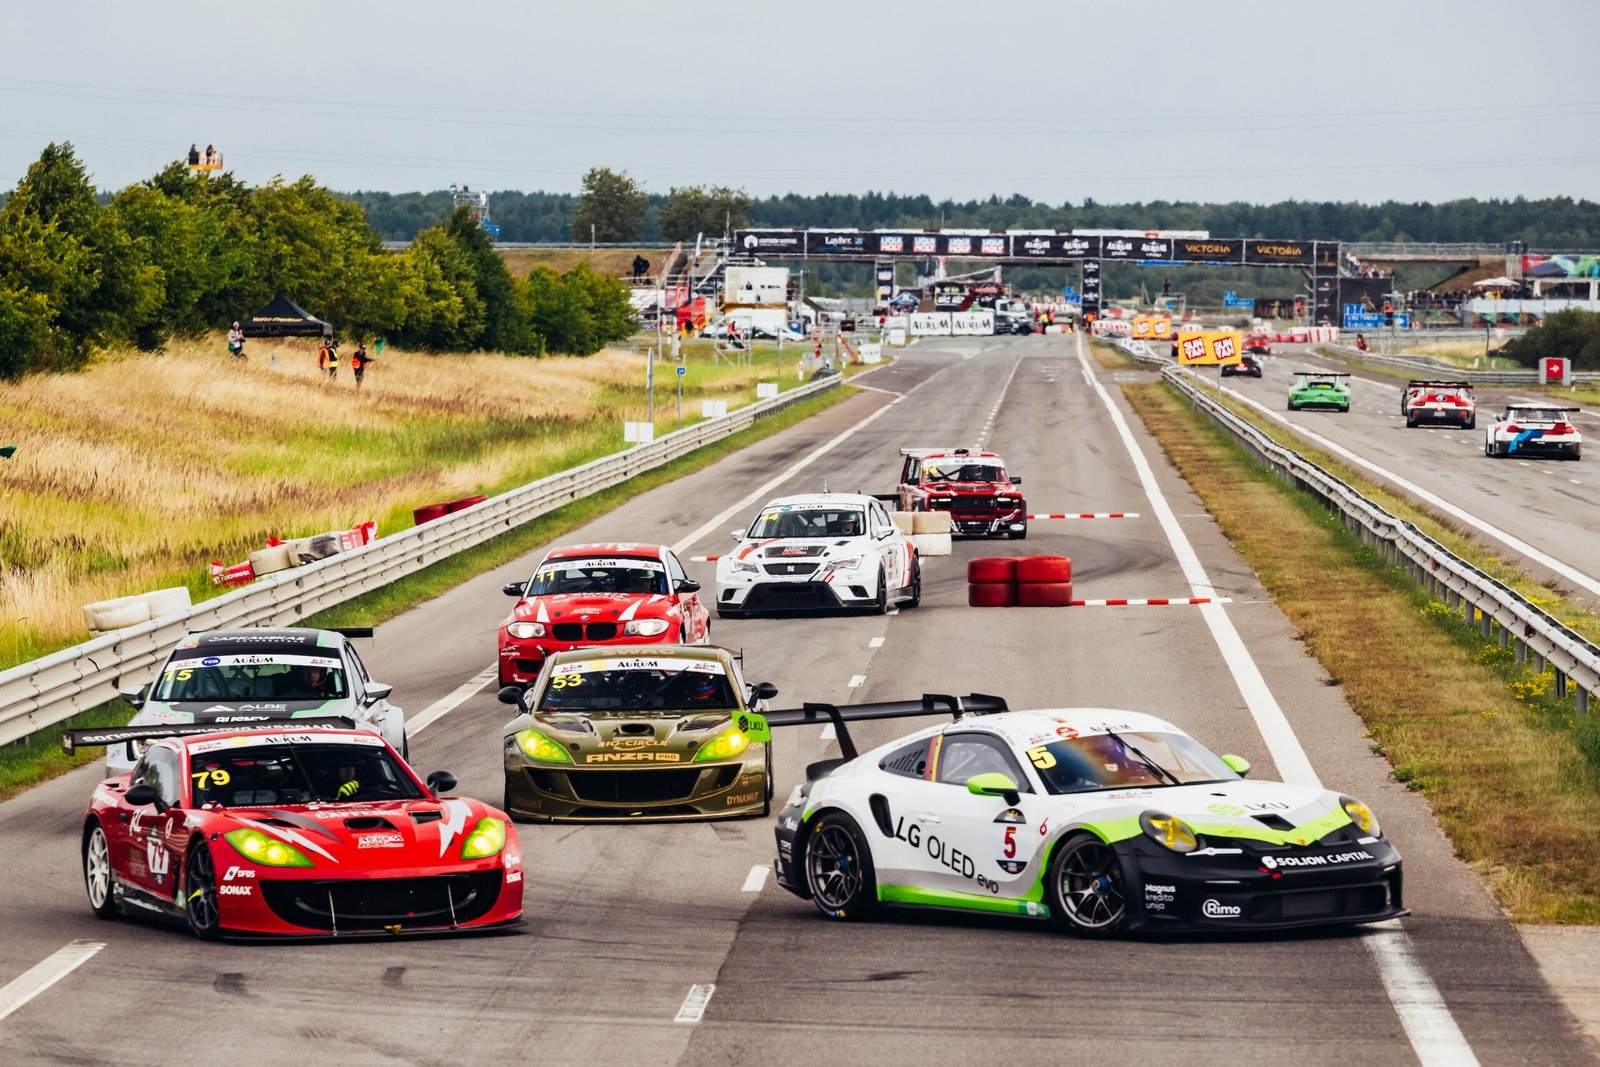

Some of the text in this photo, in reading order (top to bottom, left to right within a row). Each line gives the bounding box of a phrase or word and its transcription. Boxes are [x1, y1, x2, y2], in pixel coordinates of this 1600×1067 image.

[1185, 244, 1231, 253] VICTORIA
[1257, 245, 1302, 256] VICTORIA
[585, 559, 617, 567] AURUM
[537, 571, 555, 582] 11
[232, 656, 274, 664] AURUM
[617, 659, 658, 668] AURUM
[164, 669, 193, 681] 15
[552, 674, 582, 689] 53
[749, 721, 764, 731] LKU
[265, 735, 312, 743] AURUM
[586, 753, 654, 763] ANZA
[1027, 747, 1057, 769] 5
[191, 770, 230, 789] 79
[1244, 803, 1290, 811] LKU
[1039, 816, 1049, 836] 6
[1003, 826, 1017, 859] 5
[895, 815, 999, 894] LG OLED evo
[1276, 851, 1374, 866] SOLION CAPITAL
[219, 884, 253, 896] SONAX
[1145, 884, 1176, 894] Magnus
[1145, 893, 1174, 902] kredito
[1145, 902, 1166, 911] unija
[1207, 902, 1241, 914] Rimo
